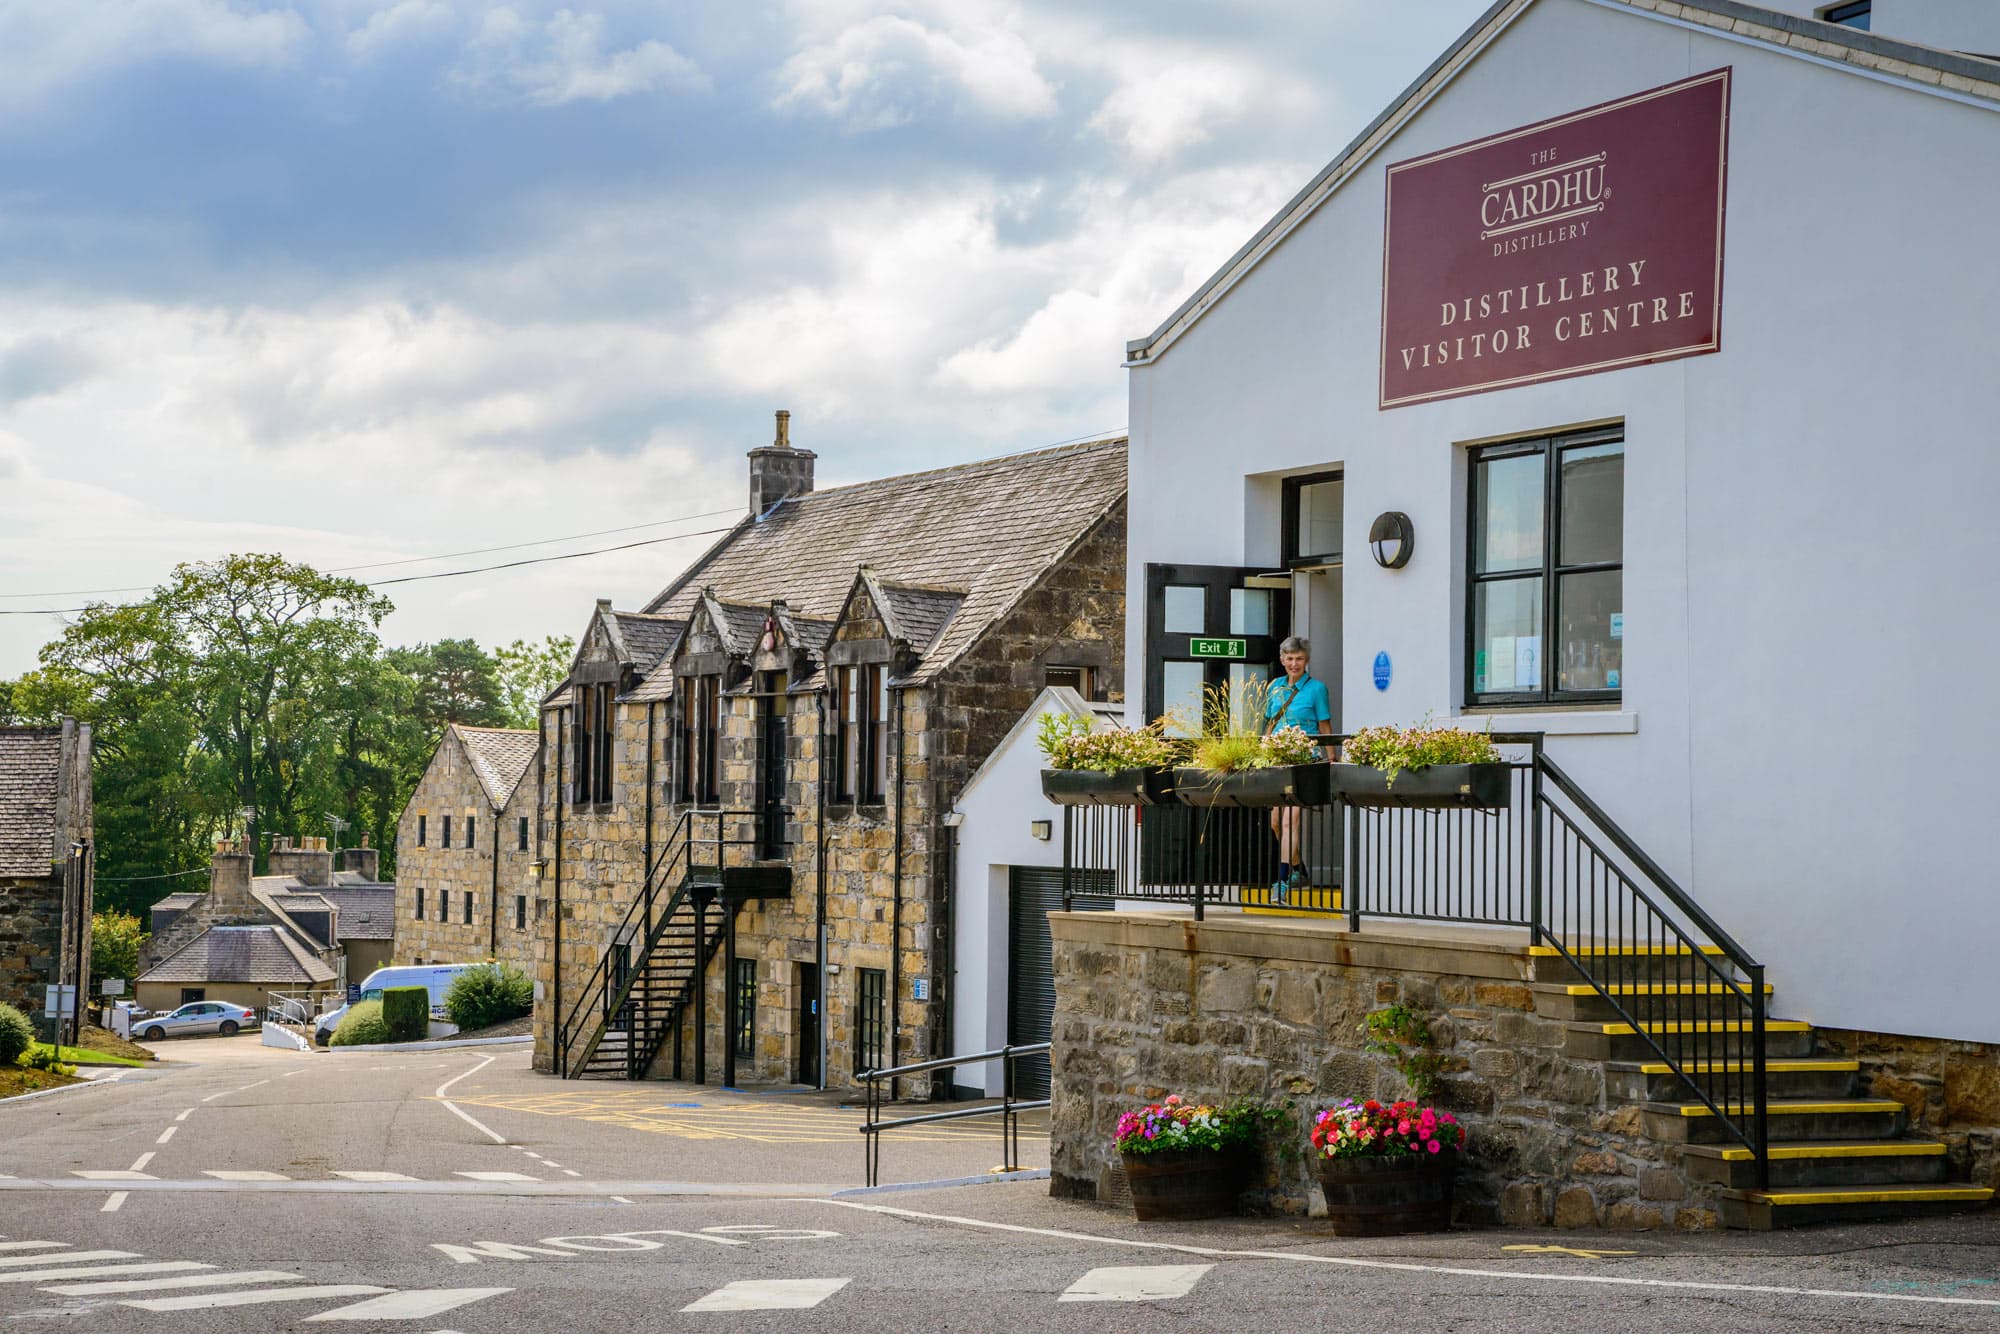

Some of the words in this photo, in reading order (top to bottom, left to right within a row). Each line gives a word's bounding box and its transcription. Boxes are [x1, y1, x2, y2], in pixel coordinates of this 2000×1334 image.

[1530, 148, 1557, 166] THE
[1493, 221, 1590, 257] DISTILLERY
[1440, 260, 1646, 326] DISTILLERY
[1401, 325, 1531, 371] VISITOR
[1554, 291, 1695, 342] CENTRE
[1199, 642, 1221, 654] Exit
